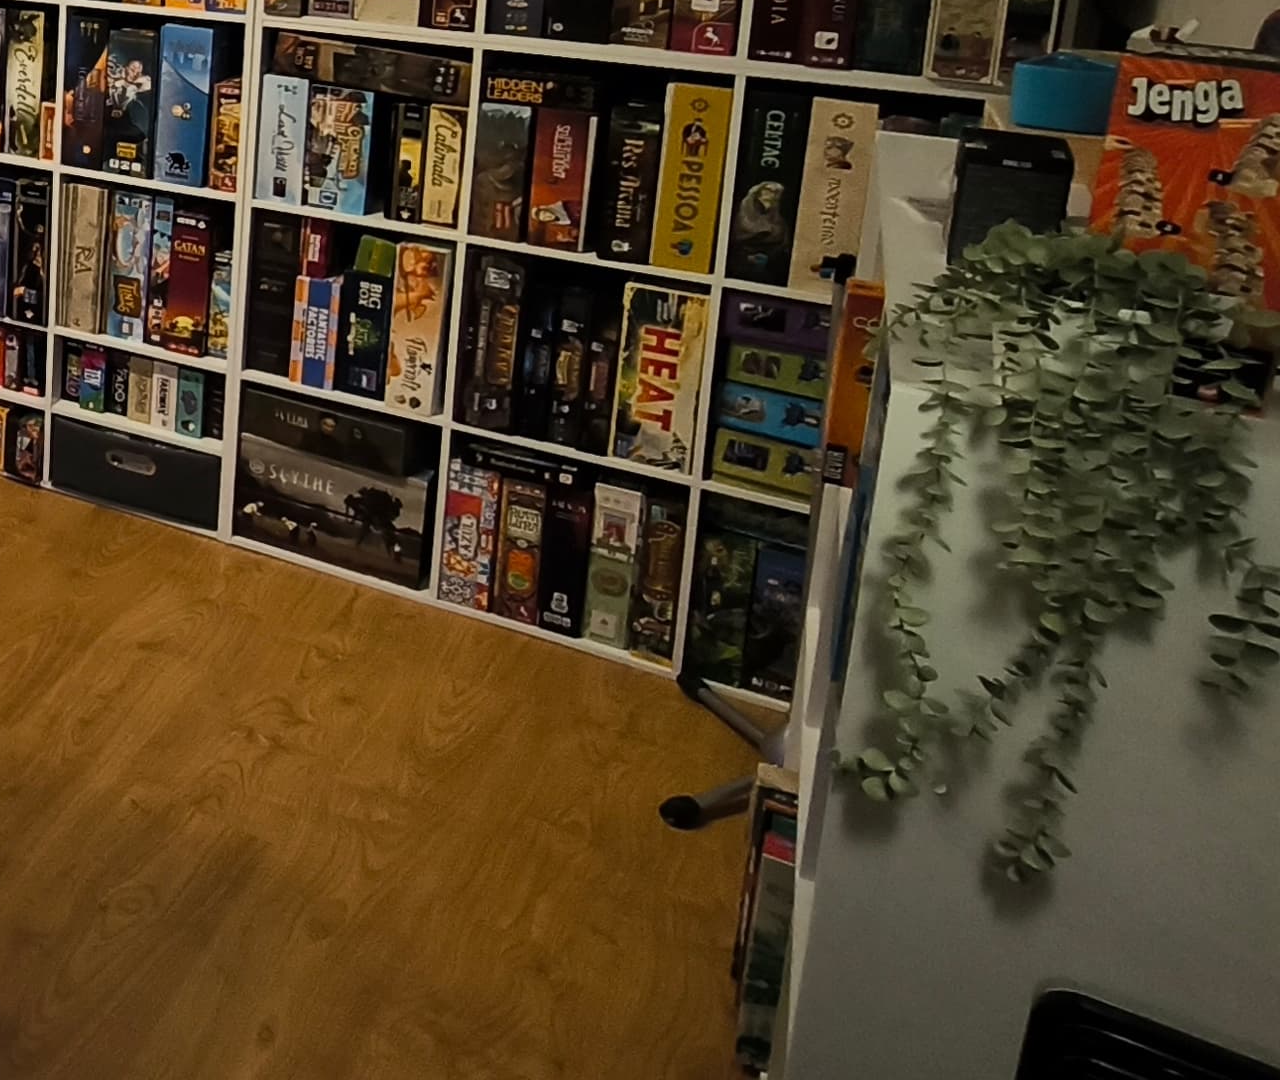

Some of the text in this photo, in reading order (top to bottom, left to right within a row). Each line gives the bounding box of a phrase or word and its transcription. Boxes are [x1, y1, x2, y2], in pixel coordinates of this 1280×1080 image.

[13, 44, 39, 129] Everdell
[486, 86, 543, 104] LEADERS
[488, 77, 544, 96] HIDDEN
[1127, 77, 1245, 124] Jenga
[671, 159, 704, 235] PESSOA
[174, 240, 207, 256] CATAN
[357, 280, 372, 309] BOX
[368, 281, 384, 311] BIG
[304, 305, 318, 360] FACTORIES
[314, 307, 329, 361] FANTASTIC
[633, 326, 683, 433] HEAT
[269, 464, 336, 496] SCYTHE
[460, 517, 475, 556] AZUL
